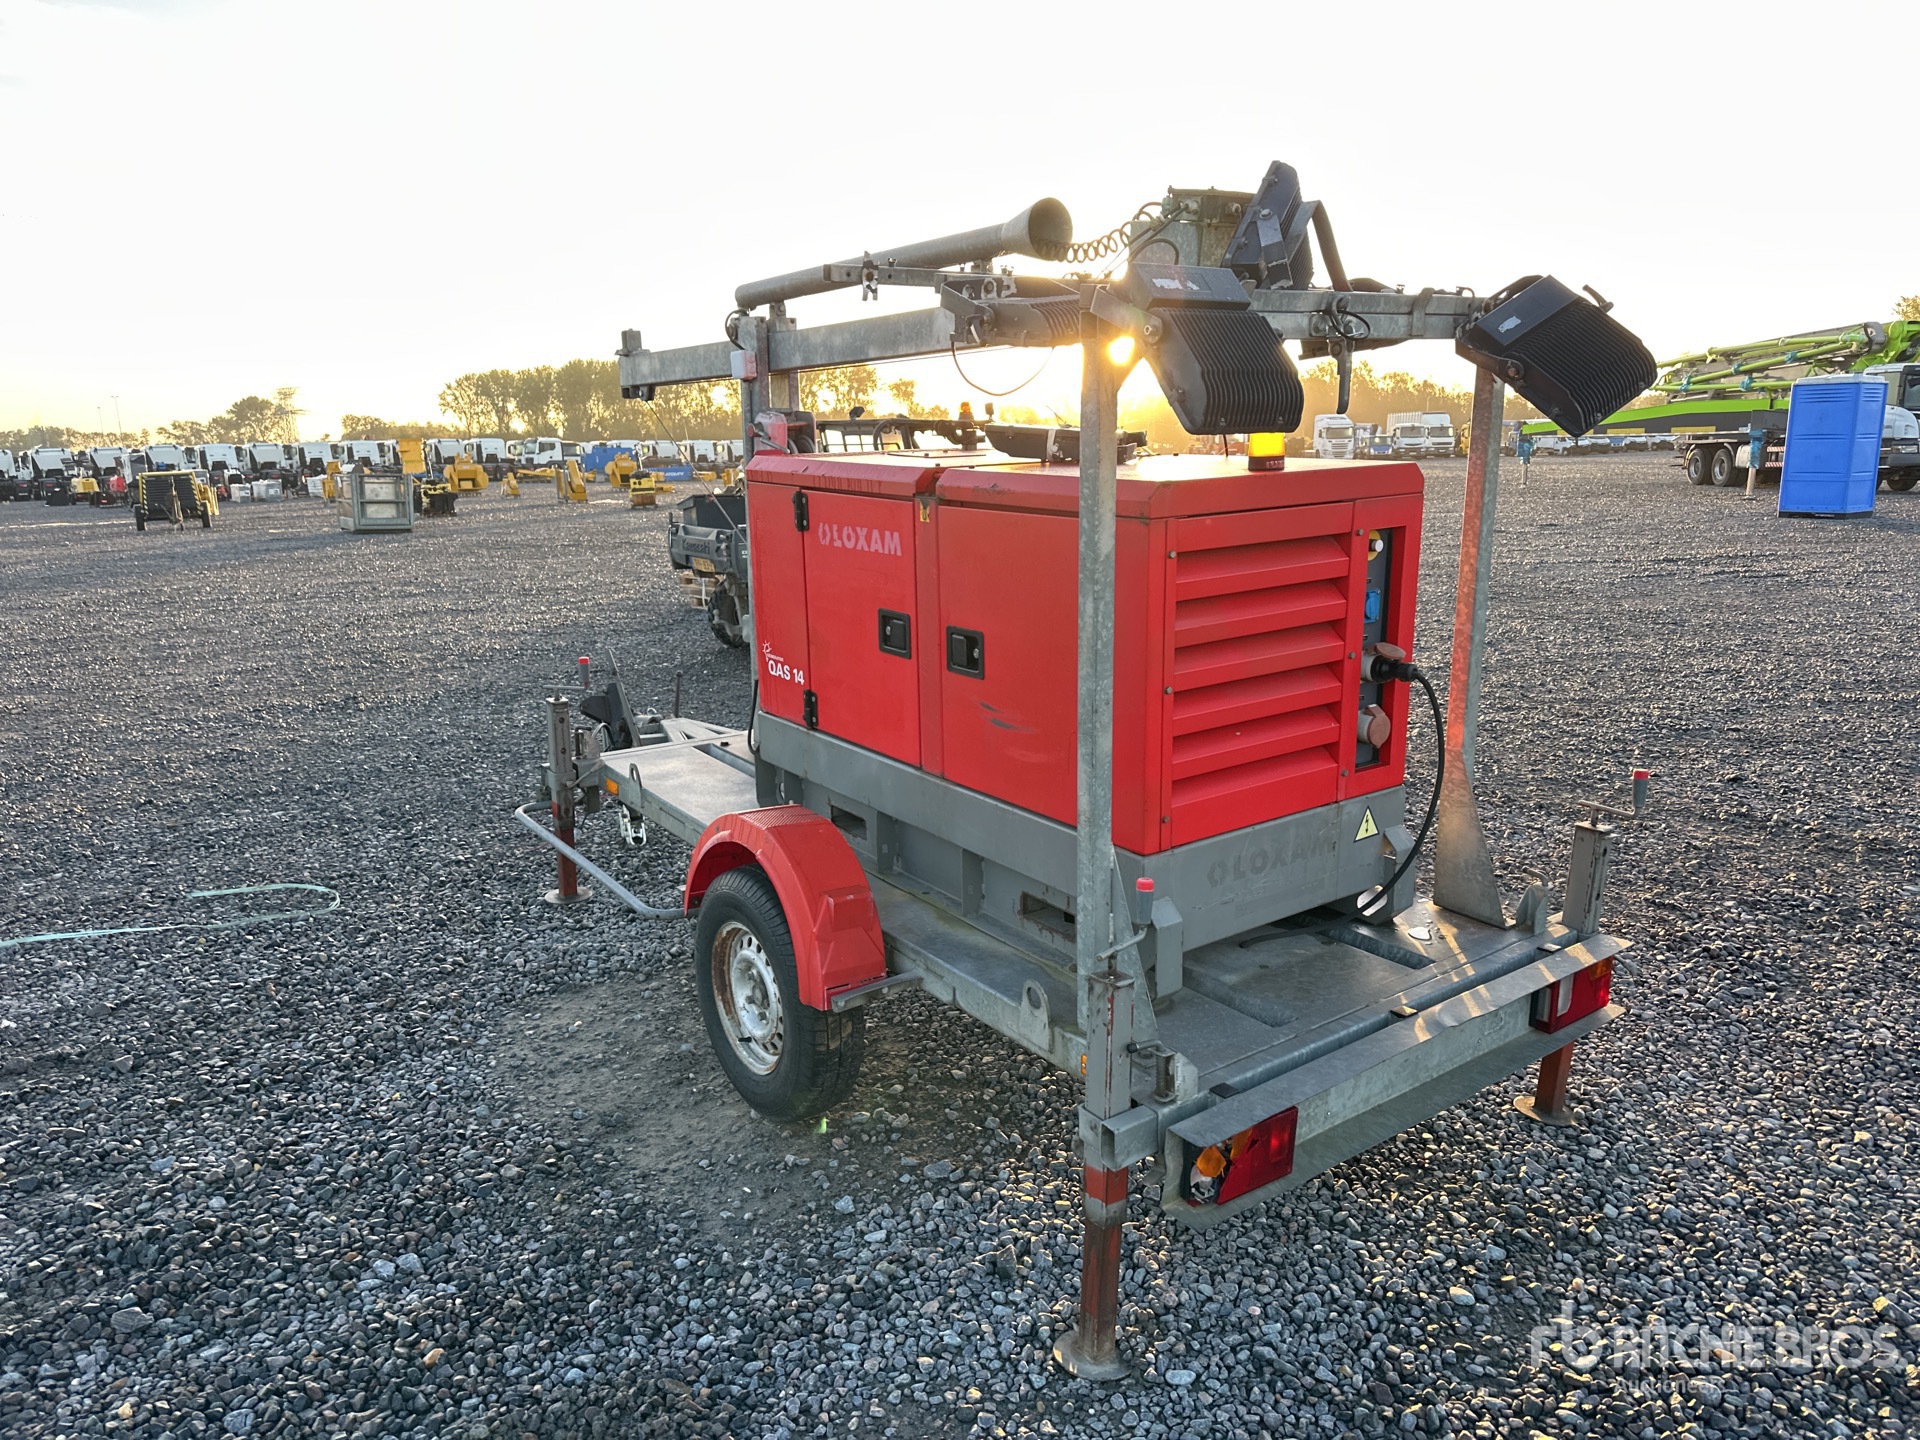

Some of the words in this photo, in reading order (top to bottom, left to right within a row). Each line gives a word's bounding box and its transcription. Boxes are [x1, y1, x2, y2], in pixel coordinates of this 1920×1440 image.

[832, 524, 902, 556] LOXAM
[768, 660, 791, 680] QAS
[793, 668, 805, 685] 14
